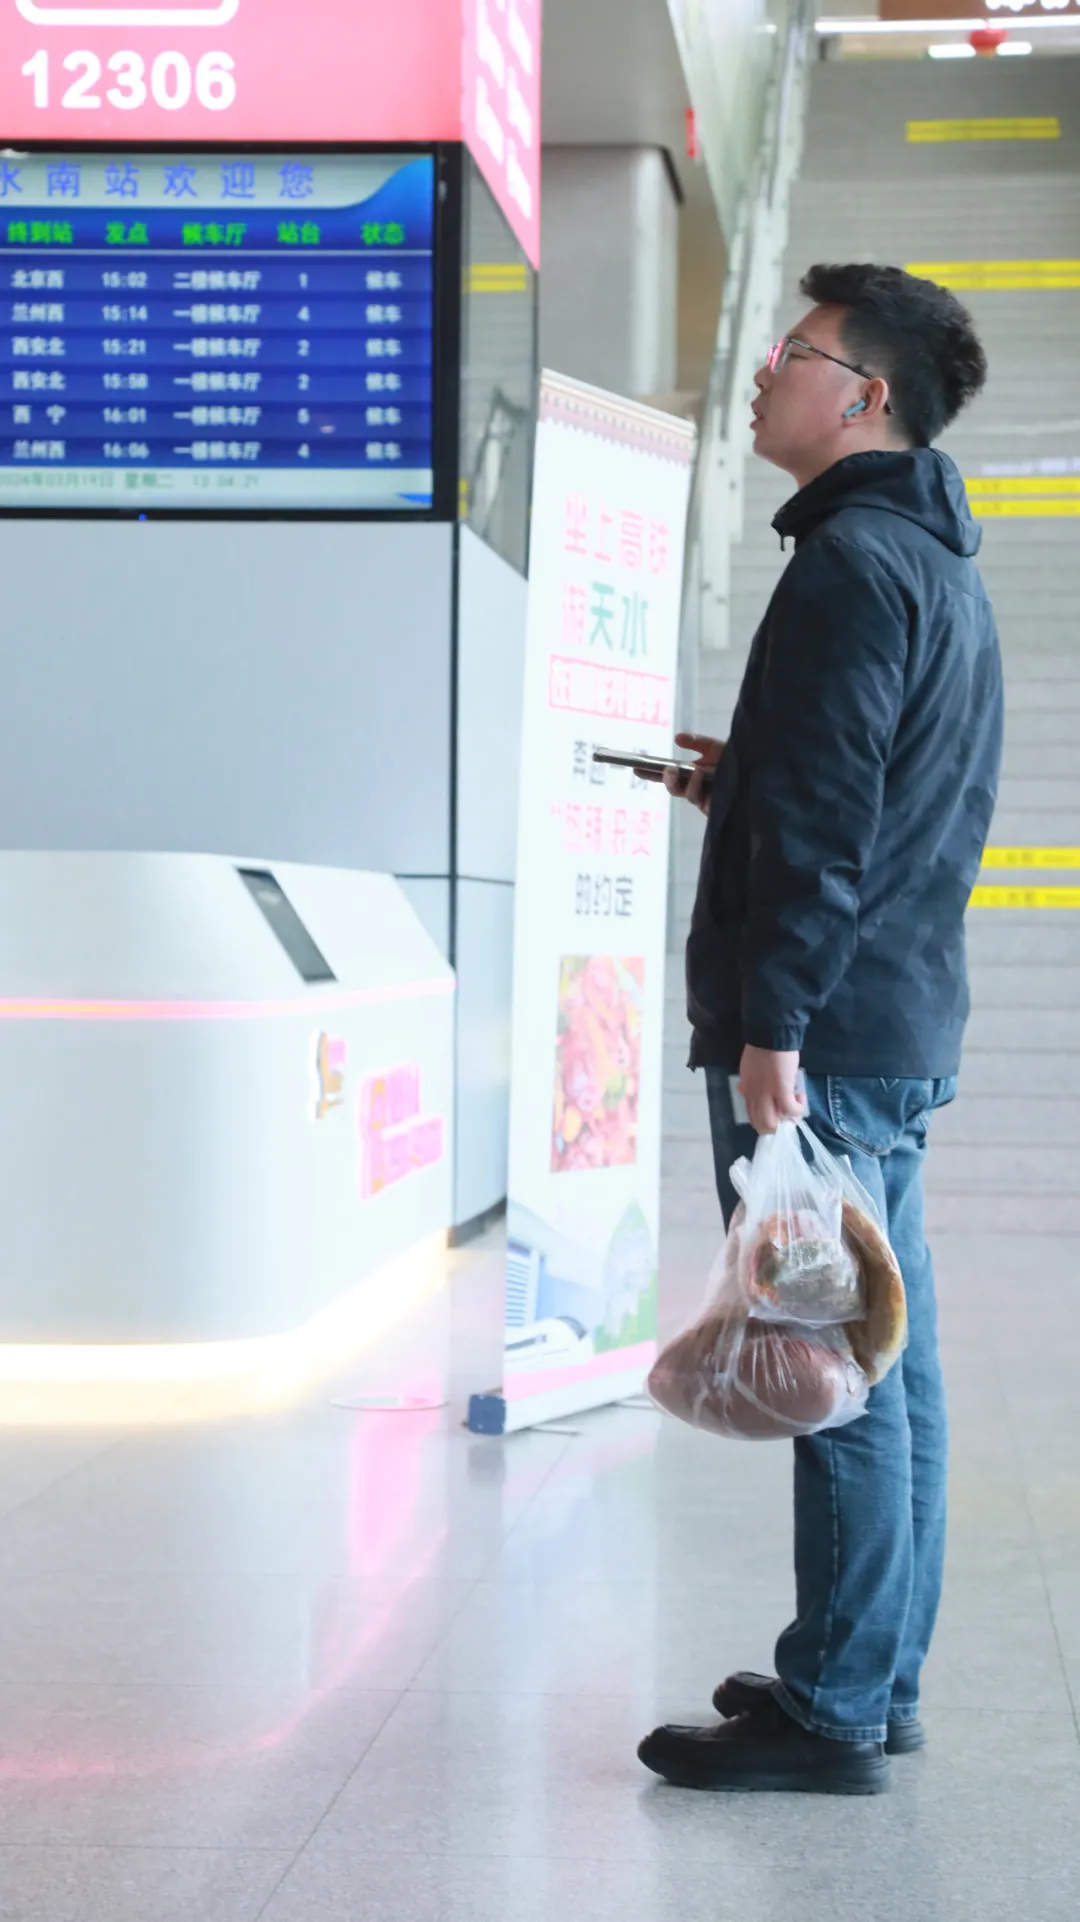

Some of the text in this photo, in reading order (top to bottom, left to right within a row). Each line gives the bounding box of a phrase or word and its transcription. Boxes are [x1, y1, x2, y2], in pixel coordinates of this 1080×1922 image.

[21, 49, 237, 110] 12306
[7, 221, 404, 245] 终到站 发点 候车厅 站台 状态
[12, 270, 64, 289] 北京西
[173, 271, 261, 290] 二楼候车厅
[299, 272, 308, 289] 1
[366, 271, 401, 290] 候车
[12, 303, 401, 323] 兰州西 15:14 一楼候车厅 4 候车
[12, 337, 401, 357] 西安北 15:21 一楼候车厅 2 候车
[12, 371, 65, 390] 西安北
[173, 372, 261, 391] 一楼候车厅
[298, 373, 309, 390] 2
[366, 372, 401, 391] 候车
[173, 405, 261, 425] 一楼候车厅
[366, 405, 401, 425] 候车
[12, 440, 64, 459] 兰州西
[173, 441, 261, 460] 一楼候车厅
[298, 443, 309, 460] 4
[366, 441, 401, 460] 候车
[563, 492, 669, 576] 坐上高铁
[575, 872, 633, 917] 的约定
